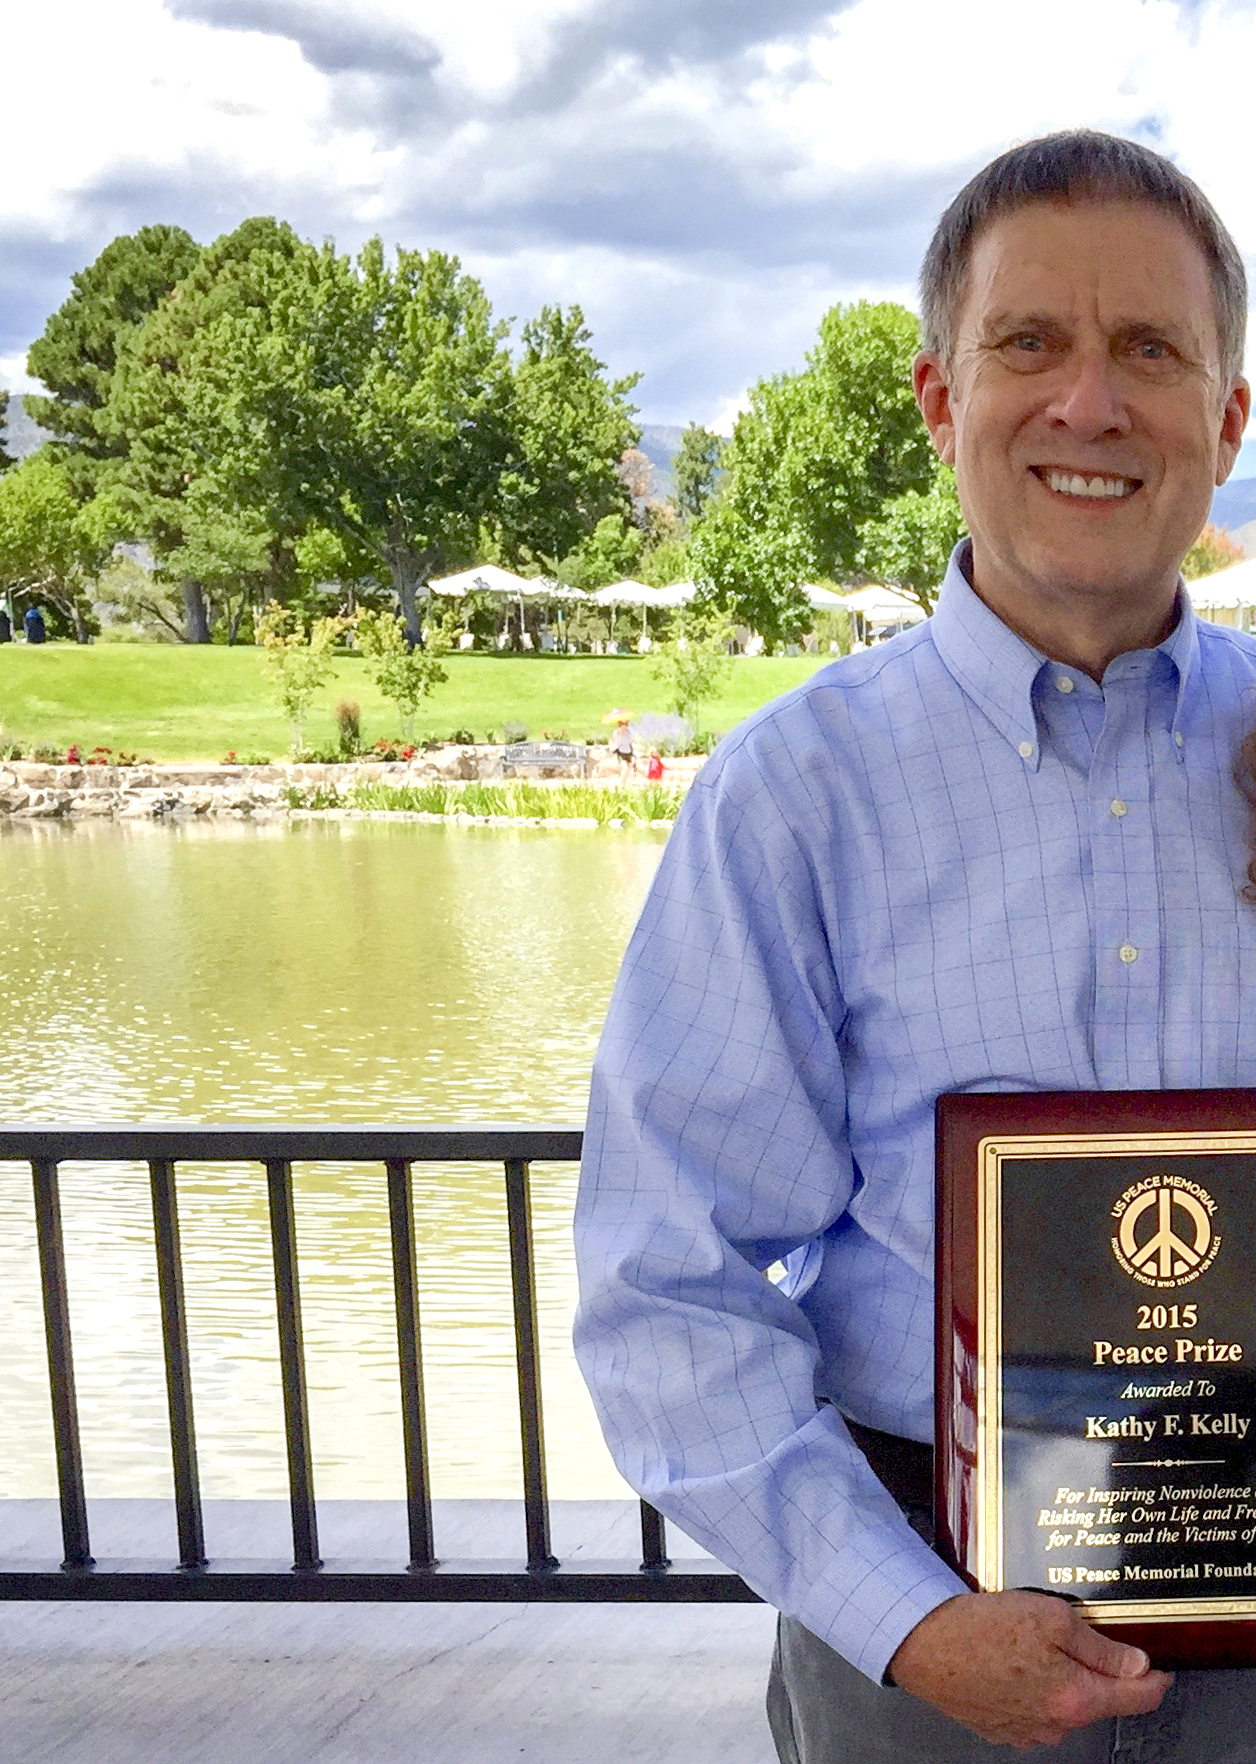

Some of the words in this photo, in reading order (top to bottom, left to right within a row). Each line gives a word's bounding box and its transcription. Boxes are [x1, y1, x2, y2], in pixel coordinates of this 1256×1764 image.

[1110, 1200, 1127, 1218] US
[1122, 1176, 1161, 1203] PEACE
[1163, 1175, 1219, 1217] MEMORIAL
[1111, 1237, 1134, 1275] HONORING
[1133, 1271, 1155, 1287] THOSE
[1157, 1280, 1176, 1288] WHO
[1176, 1271, 1200, 1286] STAND
[1198, 1259, 1213, 1274] FOR
[1208, 1235, 1222, 1260] PEACE
[1136, 1304, 1198, 1330] 2015
[1093, 1340, 1168, 1365] Peace
[1175, 1338, 1242, 1363] Prize
[1120, 1380, 1192, 1399] Awarded
[1197, 1380, 1216, 1397] To
[1085, 1415, 1155, 1442] Kathy
[1163, 1415, 1184, 1437] F.
[1190, 1413, 1250, 1439] Kelly
[1055, 1487, 1085, 1505] For
[1087, 1486, 1155, 1507] Inspiring
[1158, 1484, 1251, 1501] Nonviolence
[1037, 1508, 1094, 1529] Risking
[1097, 1508, 1127, 1525] Her
[1131, 1507, 1166, 1523] Own
[1170, 1505, 1199, 1525] Life
[1202, 1504, 1231, 1521] and
[1045, 1530, 1073, 1550] for
[1074, 1529, 1120, 1546] Peace
[1124, 1528, 1153, 1545] and
[1156, 1527, 1179, 1544] the
[1184, 1525, 1236, 1543] Victims
[1048, 1567, 1073, 1584] US
[1076, 1565, 1120, 1583] Peace
[1123, 1563, 1199, 1581] Memorial
